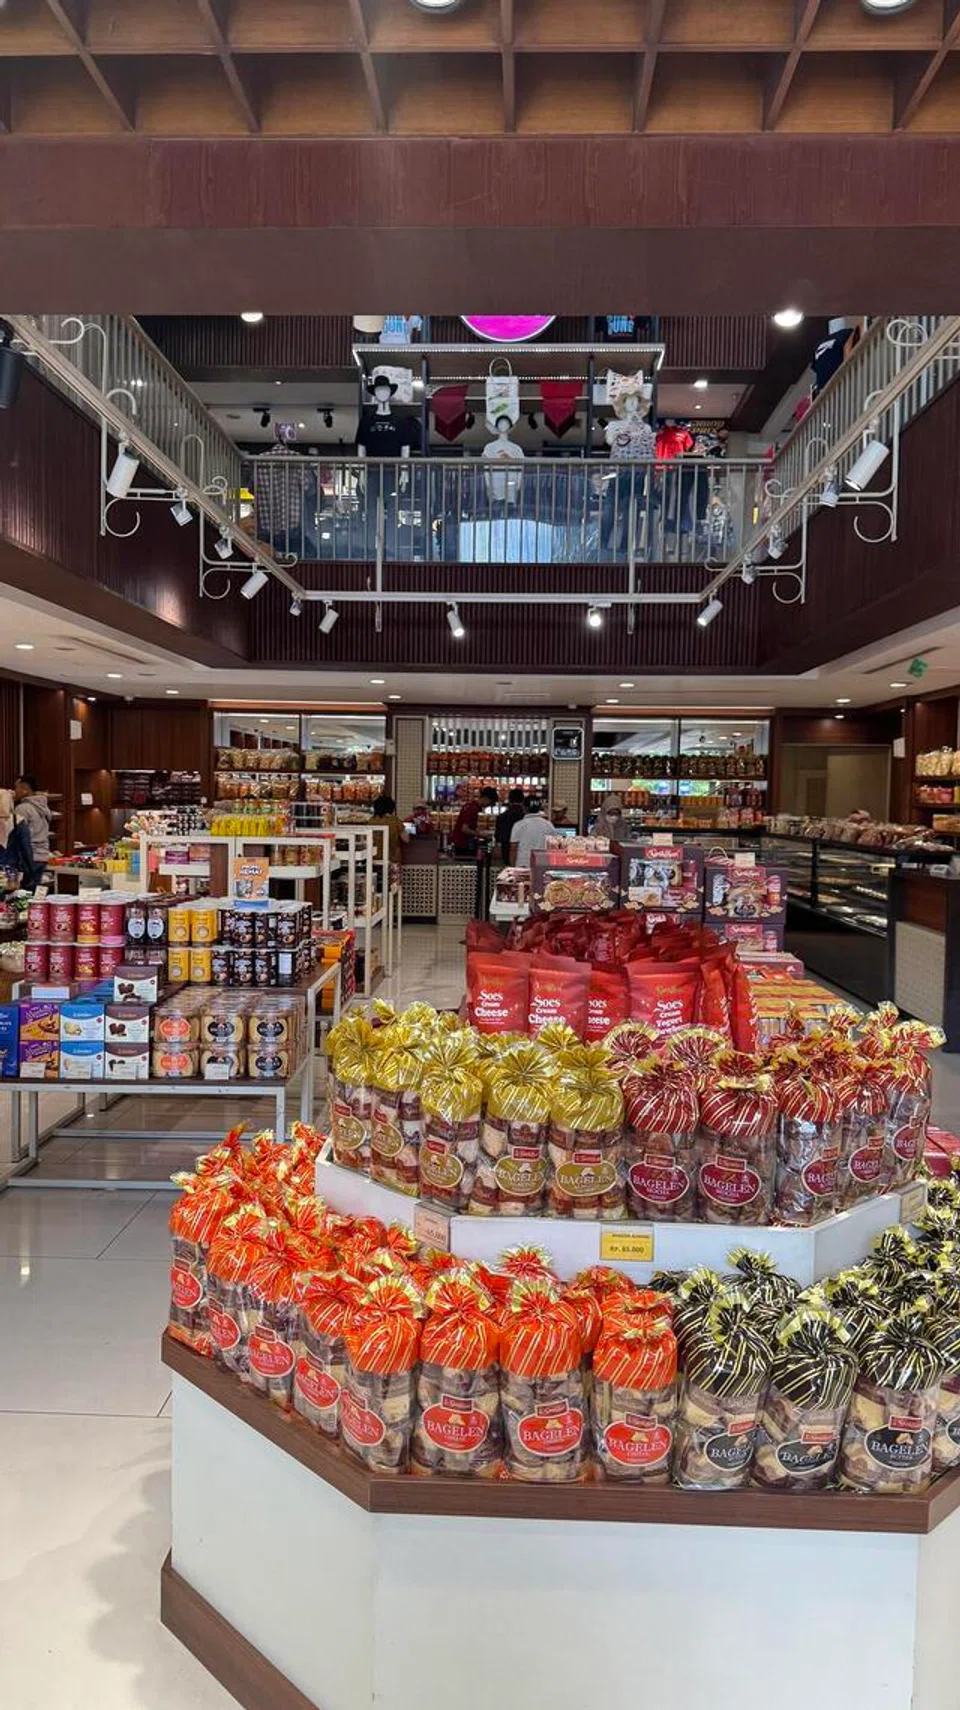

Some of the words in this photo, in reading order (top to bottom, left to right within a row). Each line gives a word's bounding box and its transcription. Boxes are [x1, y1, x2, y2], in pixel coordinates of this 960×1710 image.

[477, 988, 504, 1001] Soes
[532, 995, 561, 1007] Soes
[481, 1000, 501, 1008] Cream
[654, 999, 683, 1012] Soes
[475, 1006, 509, 1017] Cheese
[535, 1007, 558, 1015] Cream
[659, 1010, 681, 1019] Cream
[633, 1175, 685, 1192] BAGELEN
[704, 1175, 757, 1193] BAGELEN
[427, 1421, 484, 1438] BAGELEN
[523, 1425, 580, 1442] BAGELEN
[608, 1439, 668, 1452] BAGELEN
[870, 1440, 928, 1455] BAGELEN
